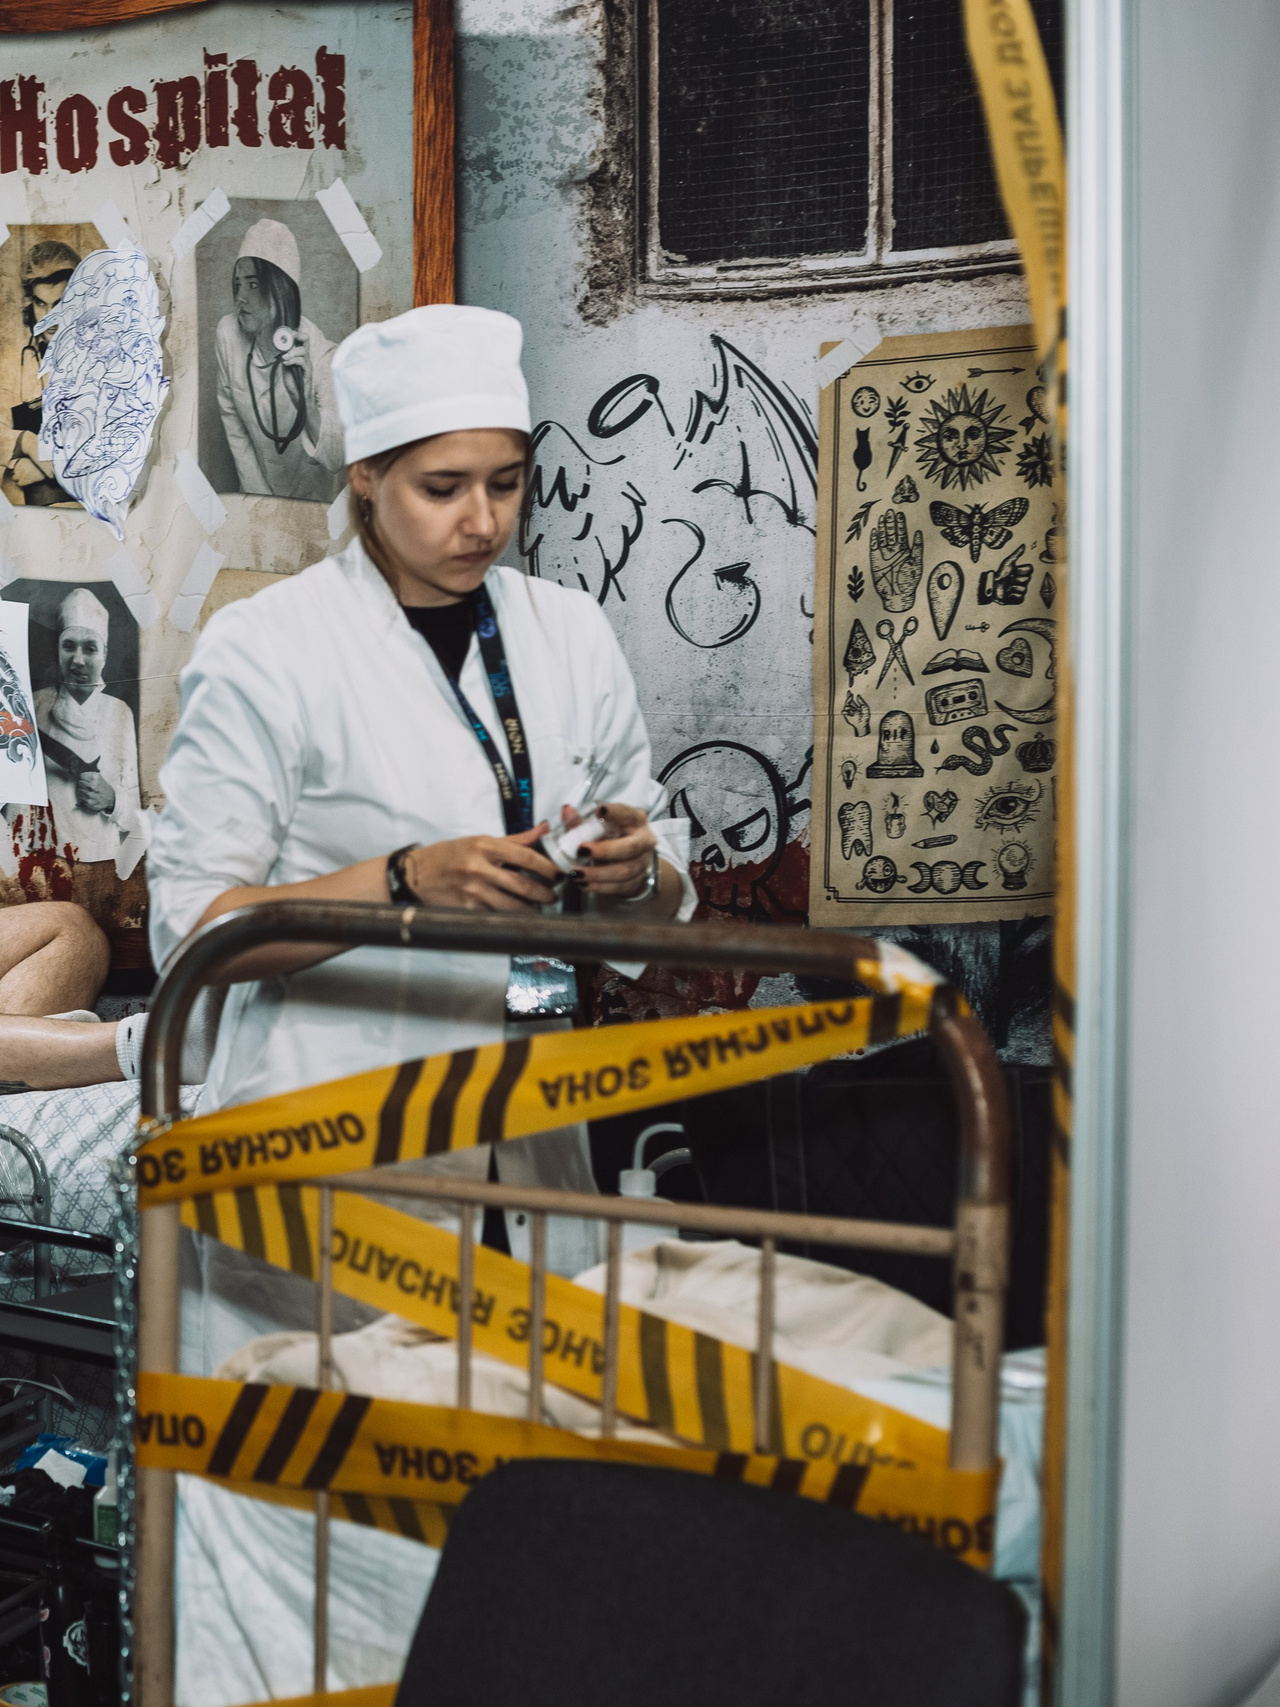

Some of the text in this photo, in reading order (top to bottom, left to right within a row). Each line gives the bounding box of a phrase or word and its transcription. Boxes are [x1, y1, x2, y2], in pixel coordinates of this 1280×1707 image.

[883, 728, 908, 741] RIP
[538, 1058, 652, 1110] ЗОНА
[200, 1113, 365, 1175] ОПАСНАЯ
